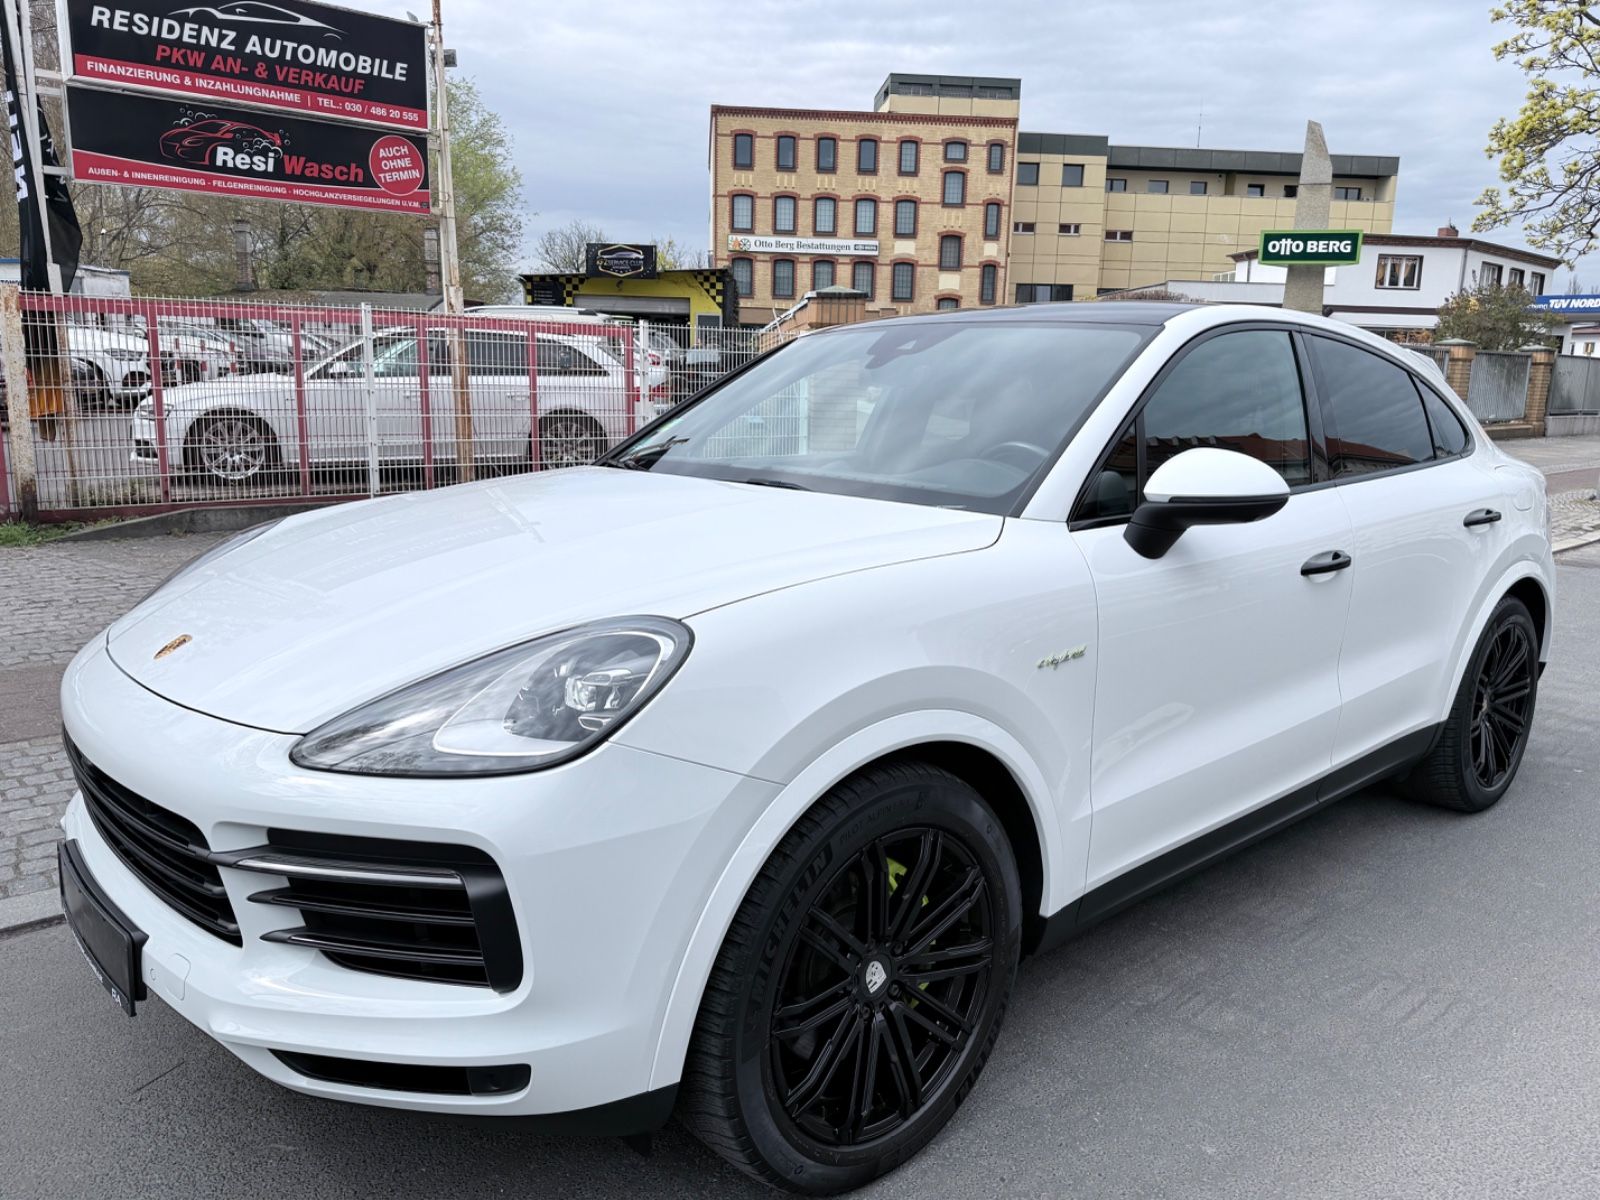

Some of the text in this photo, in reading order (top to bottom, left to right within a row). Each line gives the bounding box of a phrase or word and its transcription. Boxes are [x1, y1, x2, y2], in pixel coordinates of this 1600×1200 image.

[90, 5, 408, 81] RESIDENZ AUTOMOBILE
[155, 44, 365, 94] PKW AN- & VERKAUF
[87, 61, 180, 84] FINANZIERUNG
[184, 77, 192, 86] &
[195, 78, 301, 103] INZAHLUNGNAHME
[317, 97, 342, 109] TEL.:
[344, 102, 362, 113] 030
[370, 106, 387, 117] 486
[389, 109, 401, 119] 20
[402, 111, 419, 122] 555
[379, 145, 409, 159] AUCH
[215, 145, 364, 183] Resi Wasch
[381, 157, 412, 171] OHNE
[378, 169, 420, 184] TERMIN
[123, 171, 129, 179] &
[131, 171, 206, 186] INNENREINIGUNG
[212, 179, 287, 194] FELGENREINIGUNG
[293, 188, 401, 206] HOCHGLANZVERSIEGELUNGEN
[754, 239, 773, 248] Otto
[775, 240, 794, 250] Berg
[797, 241, 851, 252] Bestattungen
[1306, 240, 1352, 253] BERG
[1569, 298, 1600, 308] NORD
